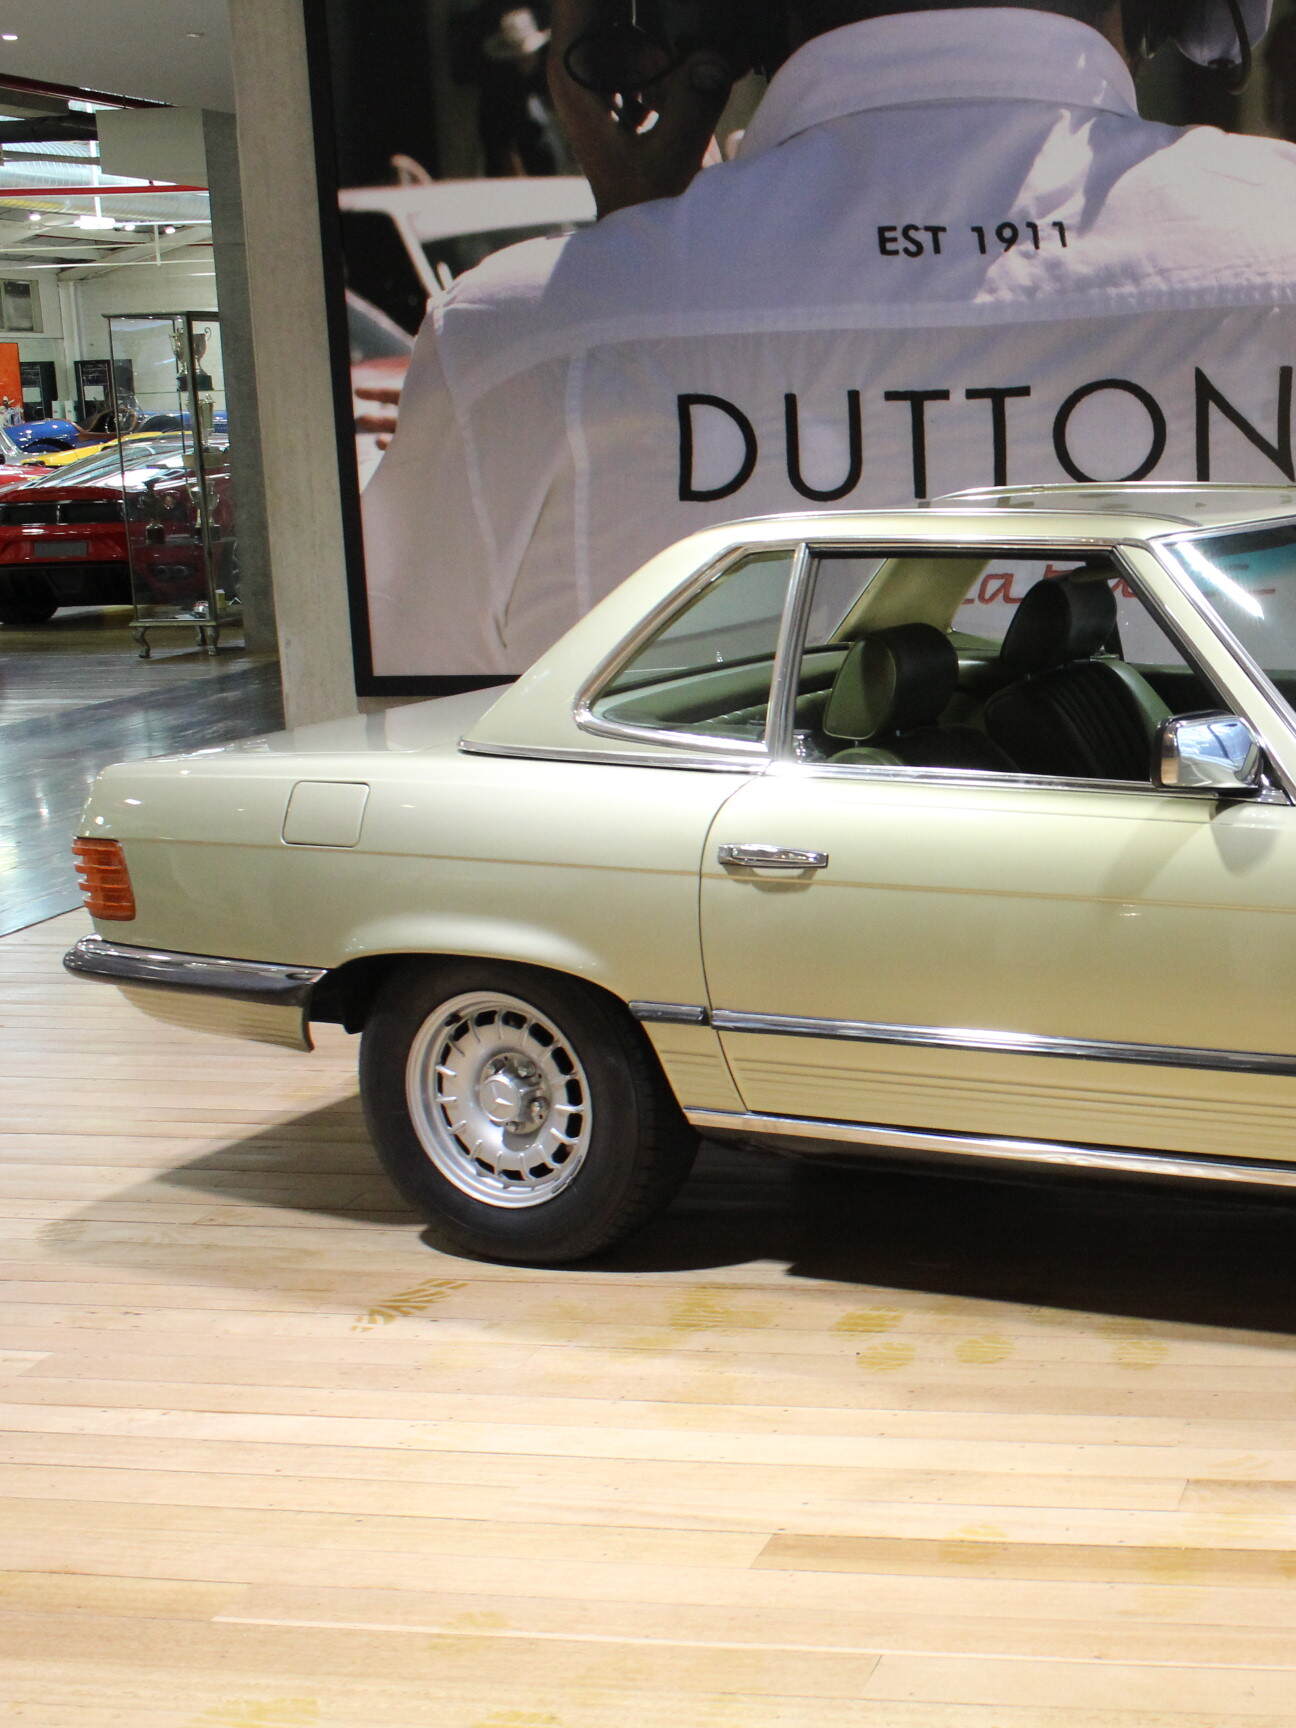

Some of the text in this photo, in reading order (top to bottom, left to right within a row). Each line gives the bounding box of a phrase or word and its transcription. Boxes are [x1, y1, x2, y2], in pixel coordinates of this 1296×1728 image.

[877, 221, 1068, 258] EST 1911
[677, 365, 1296, 502] DUTTON
